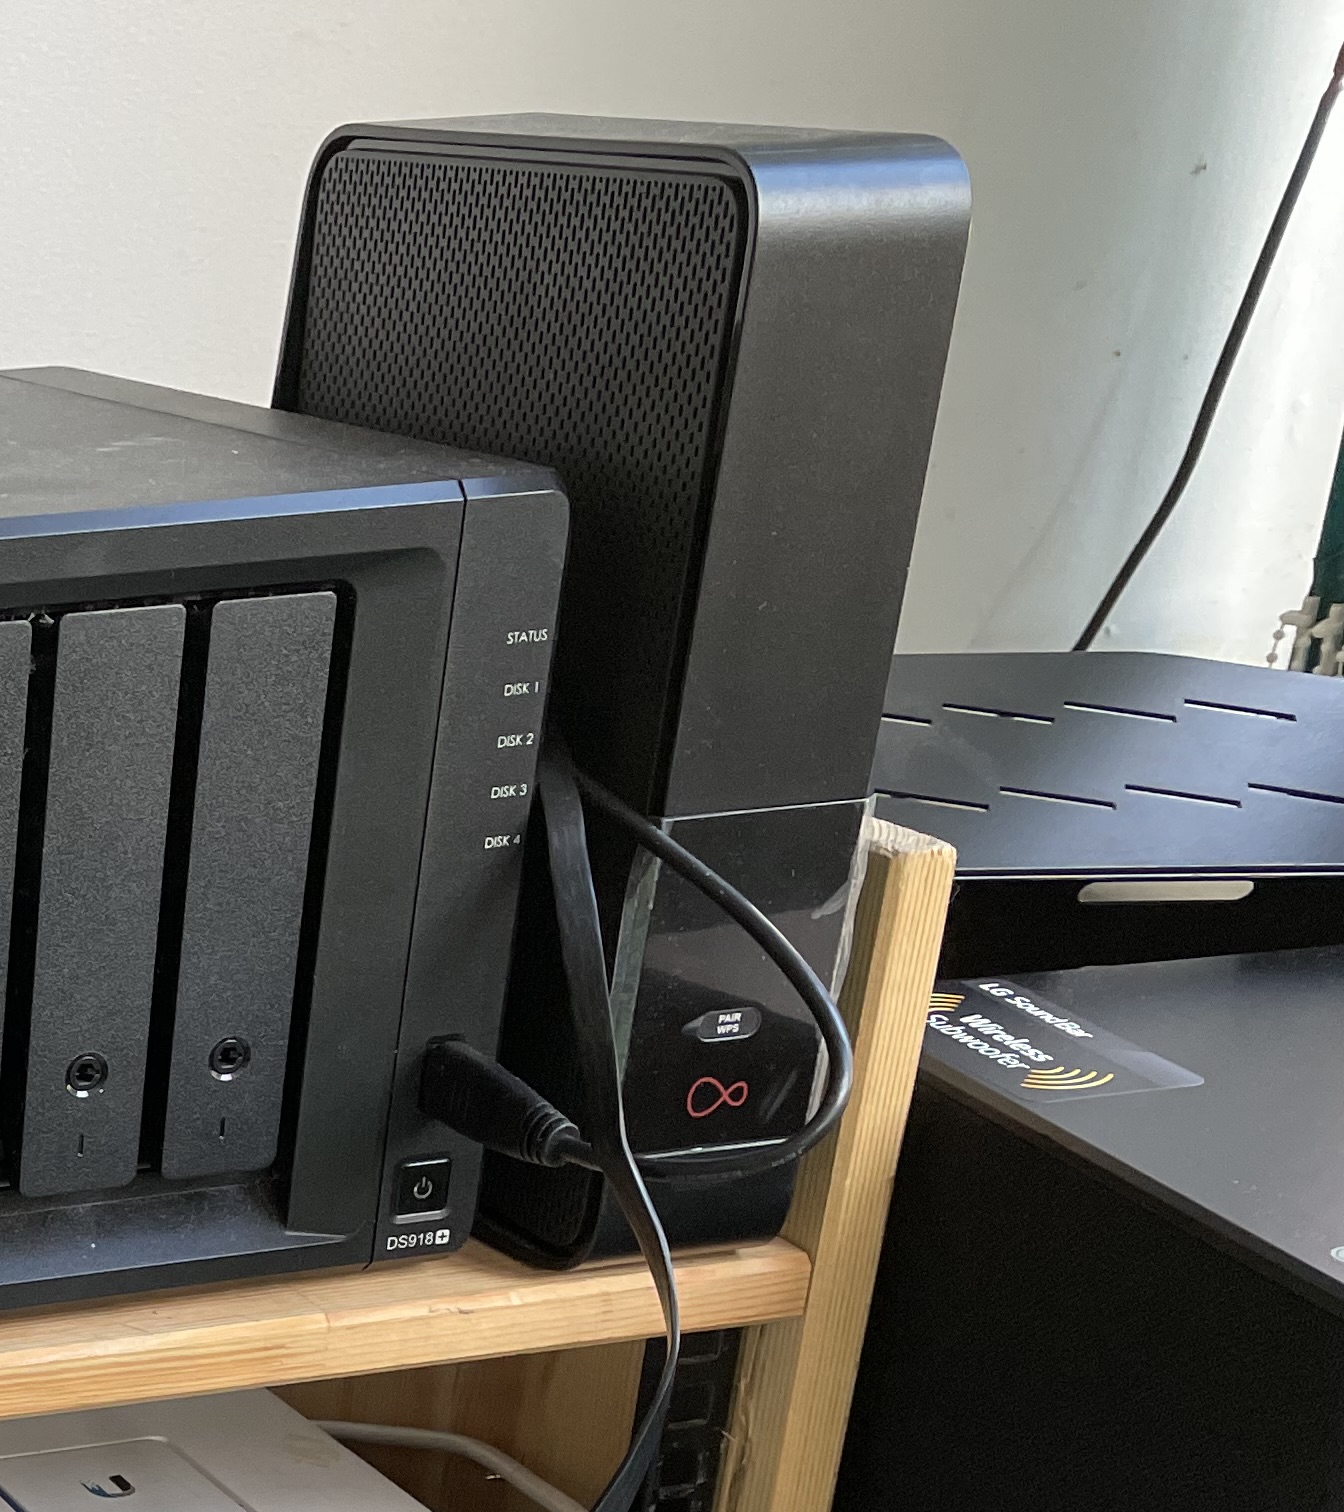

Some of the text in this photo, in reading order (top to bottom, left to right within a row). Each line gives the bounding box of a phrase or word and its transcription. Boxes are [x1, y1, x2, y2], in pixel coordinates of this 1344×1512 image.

[506, 629, 548, 645] STATUS
[504, 681, 540, 697] DISK 1
[497, 733, 534, 749] DISK 2
[490, 784, 528, 799] DISK 3
[484, 834, 521, 849] DISK 4
[979, 982, 1015, 998] LG
[718, 1012, 742, 1024] PAIR
[716, 1023, 740, 1035] WPS
[927, 1014, 1031, 1070] Subwoofer
[959, 1013, 1054, 1063] Wireless
